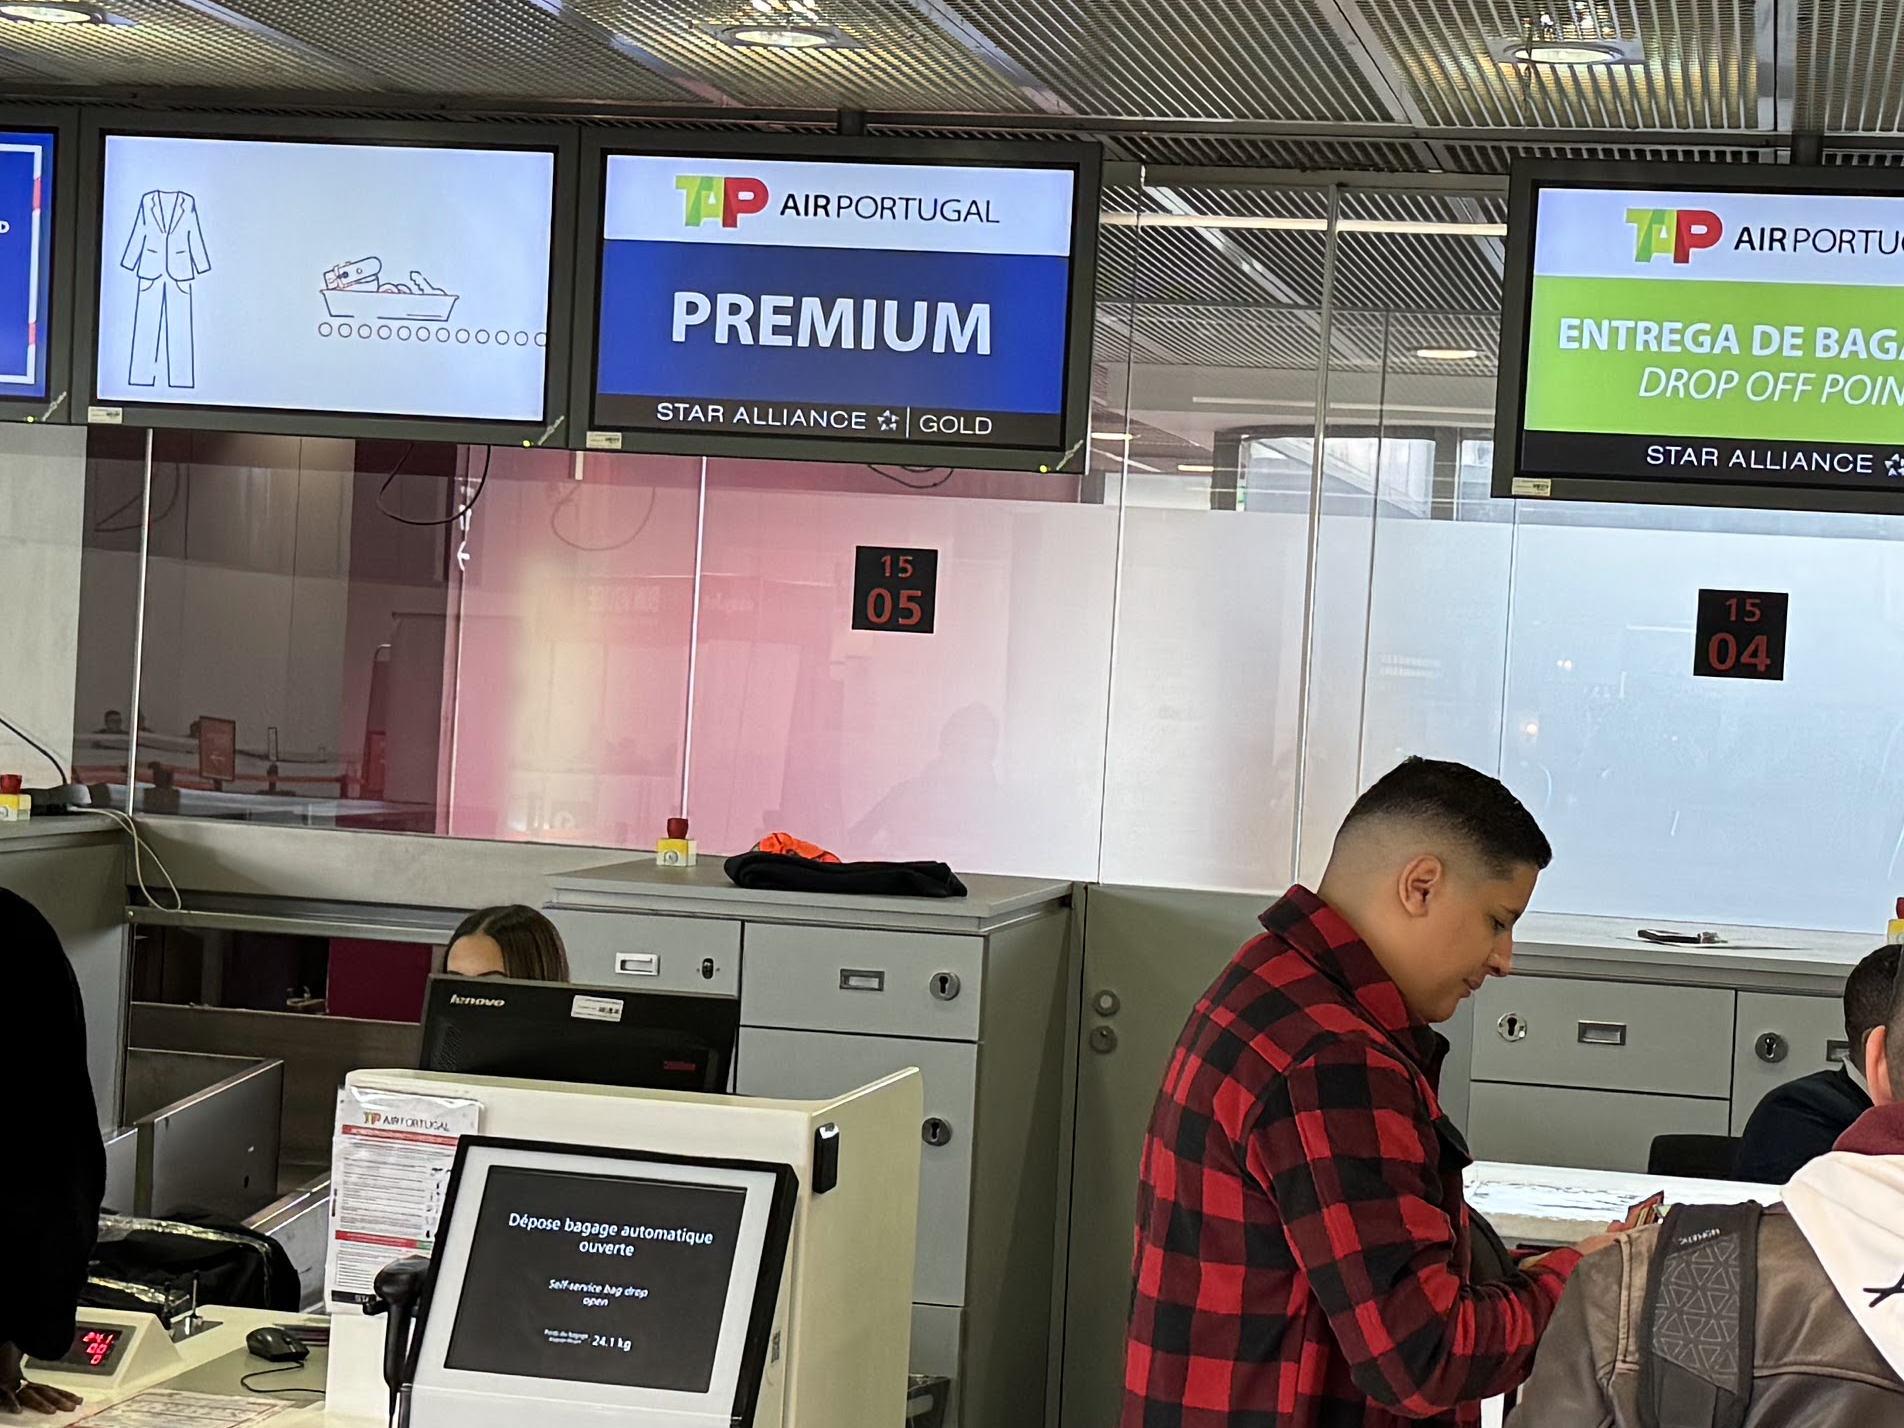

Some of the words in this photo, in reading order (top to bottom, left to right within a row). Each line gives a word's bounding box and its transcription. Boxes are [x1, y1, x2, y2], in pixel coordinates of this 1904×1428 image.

[675, 175, 769, 229] TAP
[1625, 208, 1723, 264] TAP
[671, 292, 992, 356] PREMIUM
[1558, 318, 1741, 356] ENTREGA
[1752, 324, 1806, 358] DE
[1638, 367, 1741, 401] DROP
[1746, 372, 1814, 402] OFF
[656, 403, 725, 423] STAR
[733, 405, 867, 430] ALLIANCE
[919, 415, 993, 435] GOLD
[1646, 445, 1720, 468] STAR
[1727, 448, 1874, 474] ALLIANCE
[881, 555, 914, 577] 15
[867, 588, 922, 625] 05
[1725, 597, 1762, 622] 15
[1708, 632, 1771, 672] 04
[451, 994, 505, 1007] lenovo
[508, 1213, 561, 1231] Dépose
[565, 1218, 618, 1238] bagage
[621, 1225, 714, 1246] automatique
[579, 1241, 634, 1256] ouverte
[583, 1297, 609, 1306] open
[604, 1284, 622, 1297] bag
[624, 1286, 648, 1298] drop
[592, 1335, 614, 1347] 24.1
[618, 1337, 631, 1351] kg
